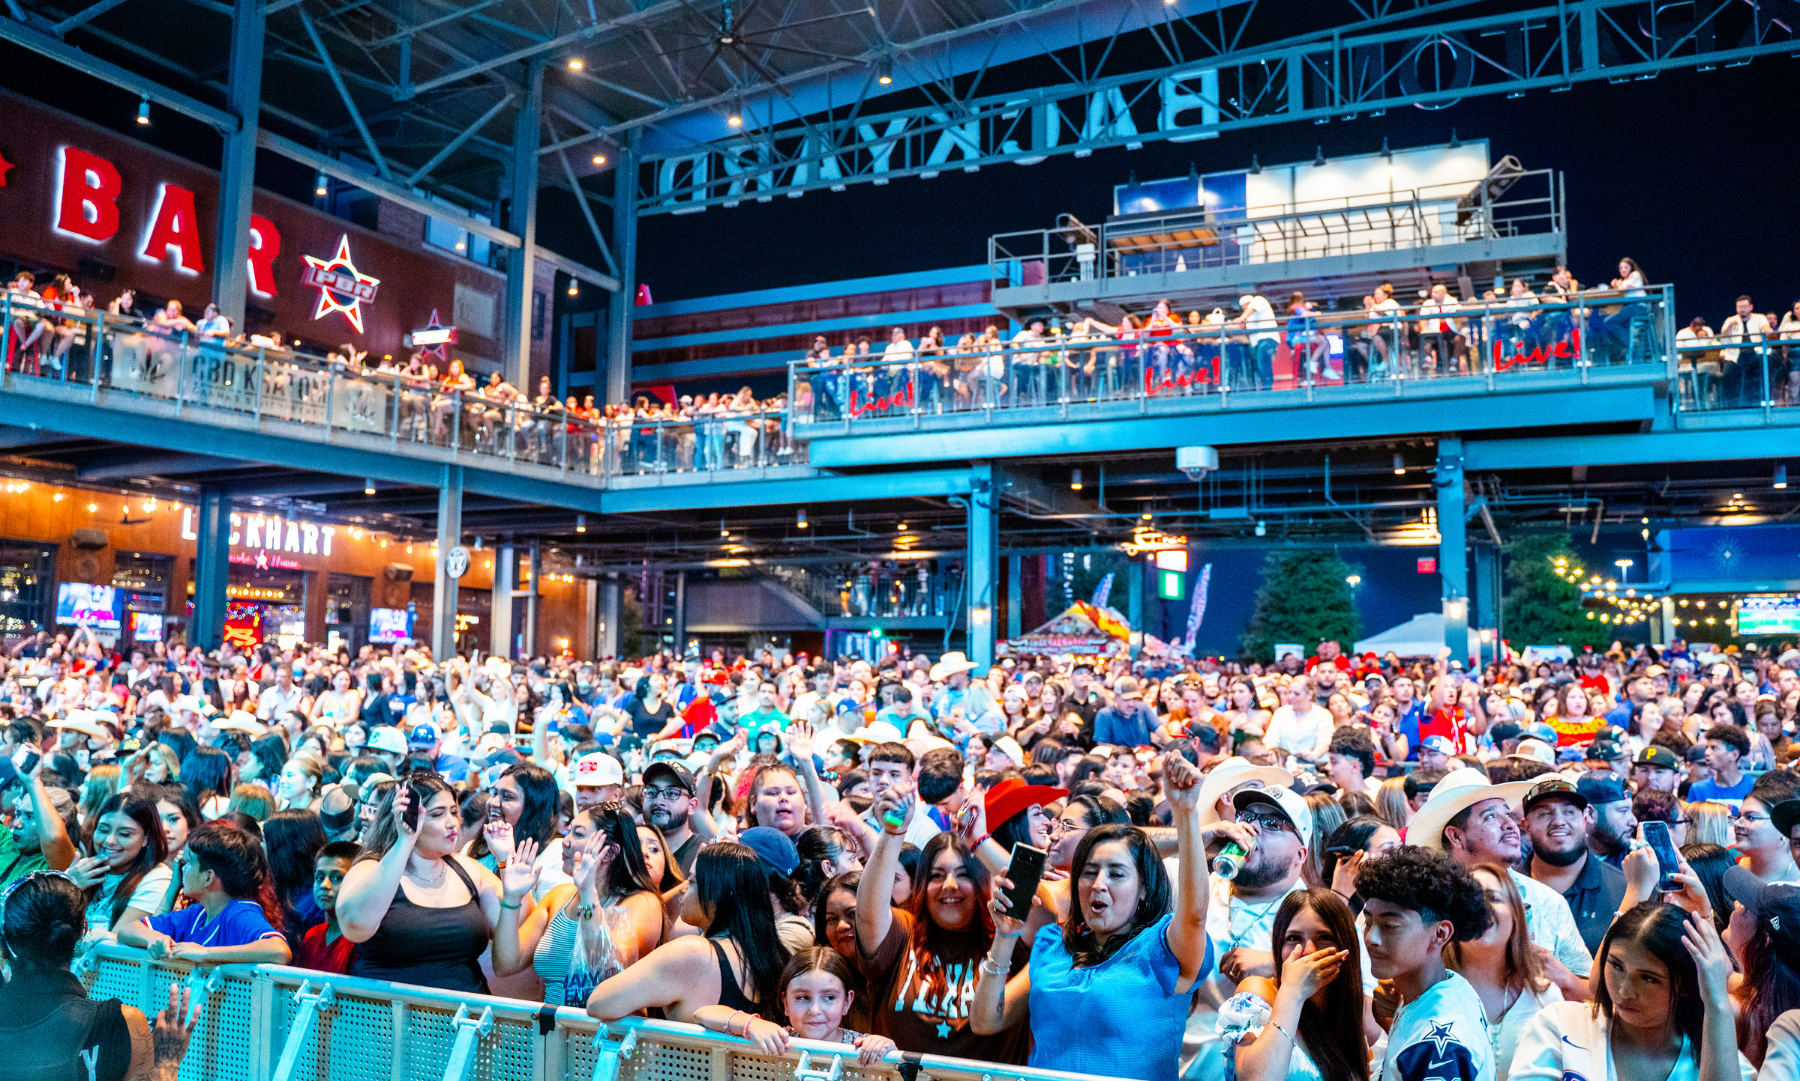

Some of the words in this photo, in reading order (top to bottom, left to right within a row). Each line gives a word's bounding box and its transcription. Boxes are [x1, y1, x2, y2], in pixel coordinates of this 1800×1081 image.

[53, 146, 281, 298] BAR
[316, 268, 374, 298] PBR
[1493, 328, 1581, 372] Live!
[1145, 356, 1220, 396] Live!
[850, 381, 914, 417] Live!
[182, 507, 336, 556] LCKHART
[1646, 748, 1657, 760] P
